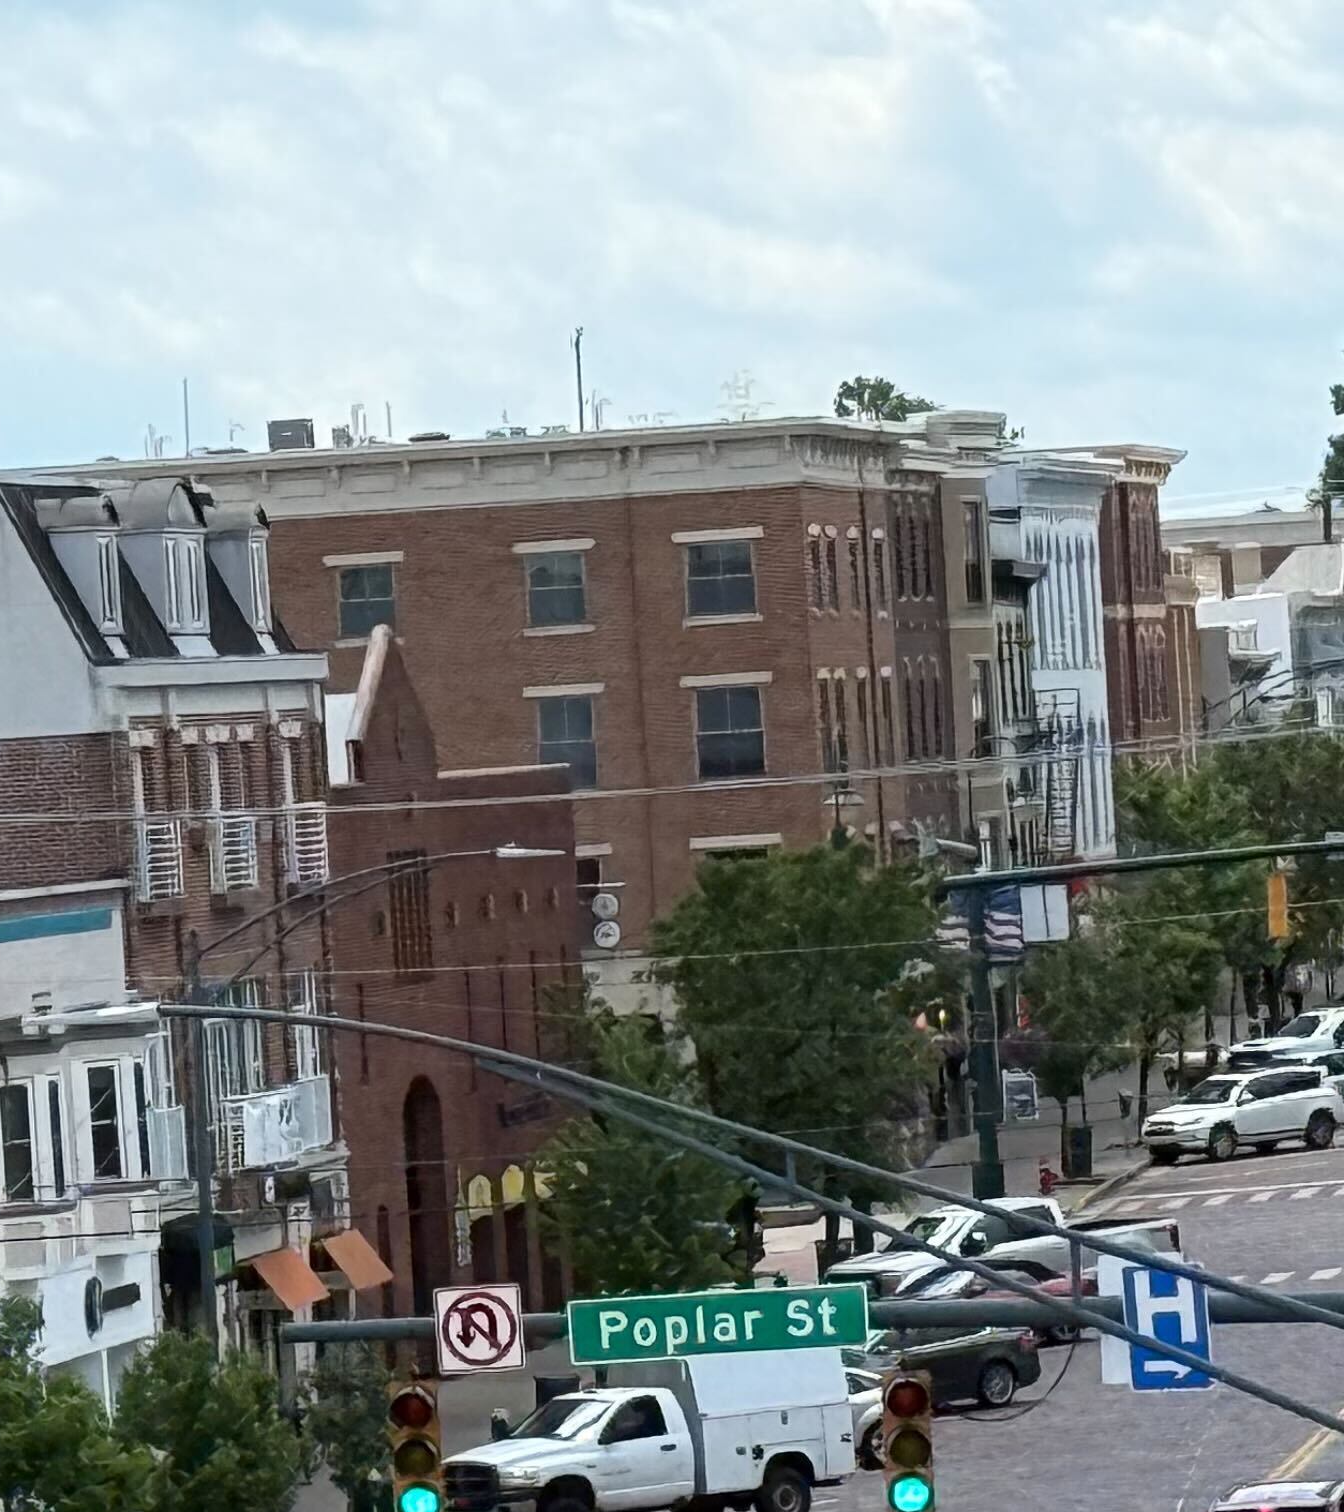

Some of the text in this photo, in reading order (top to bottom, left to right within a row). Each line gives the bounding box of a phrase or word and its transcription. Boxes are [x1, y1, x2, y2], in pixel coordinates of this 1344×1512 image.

[599, 1297, 838, 1355] Poplar St
[1133, 1270, 1197, 1344] H
